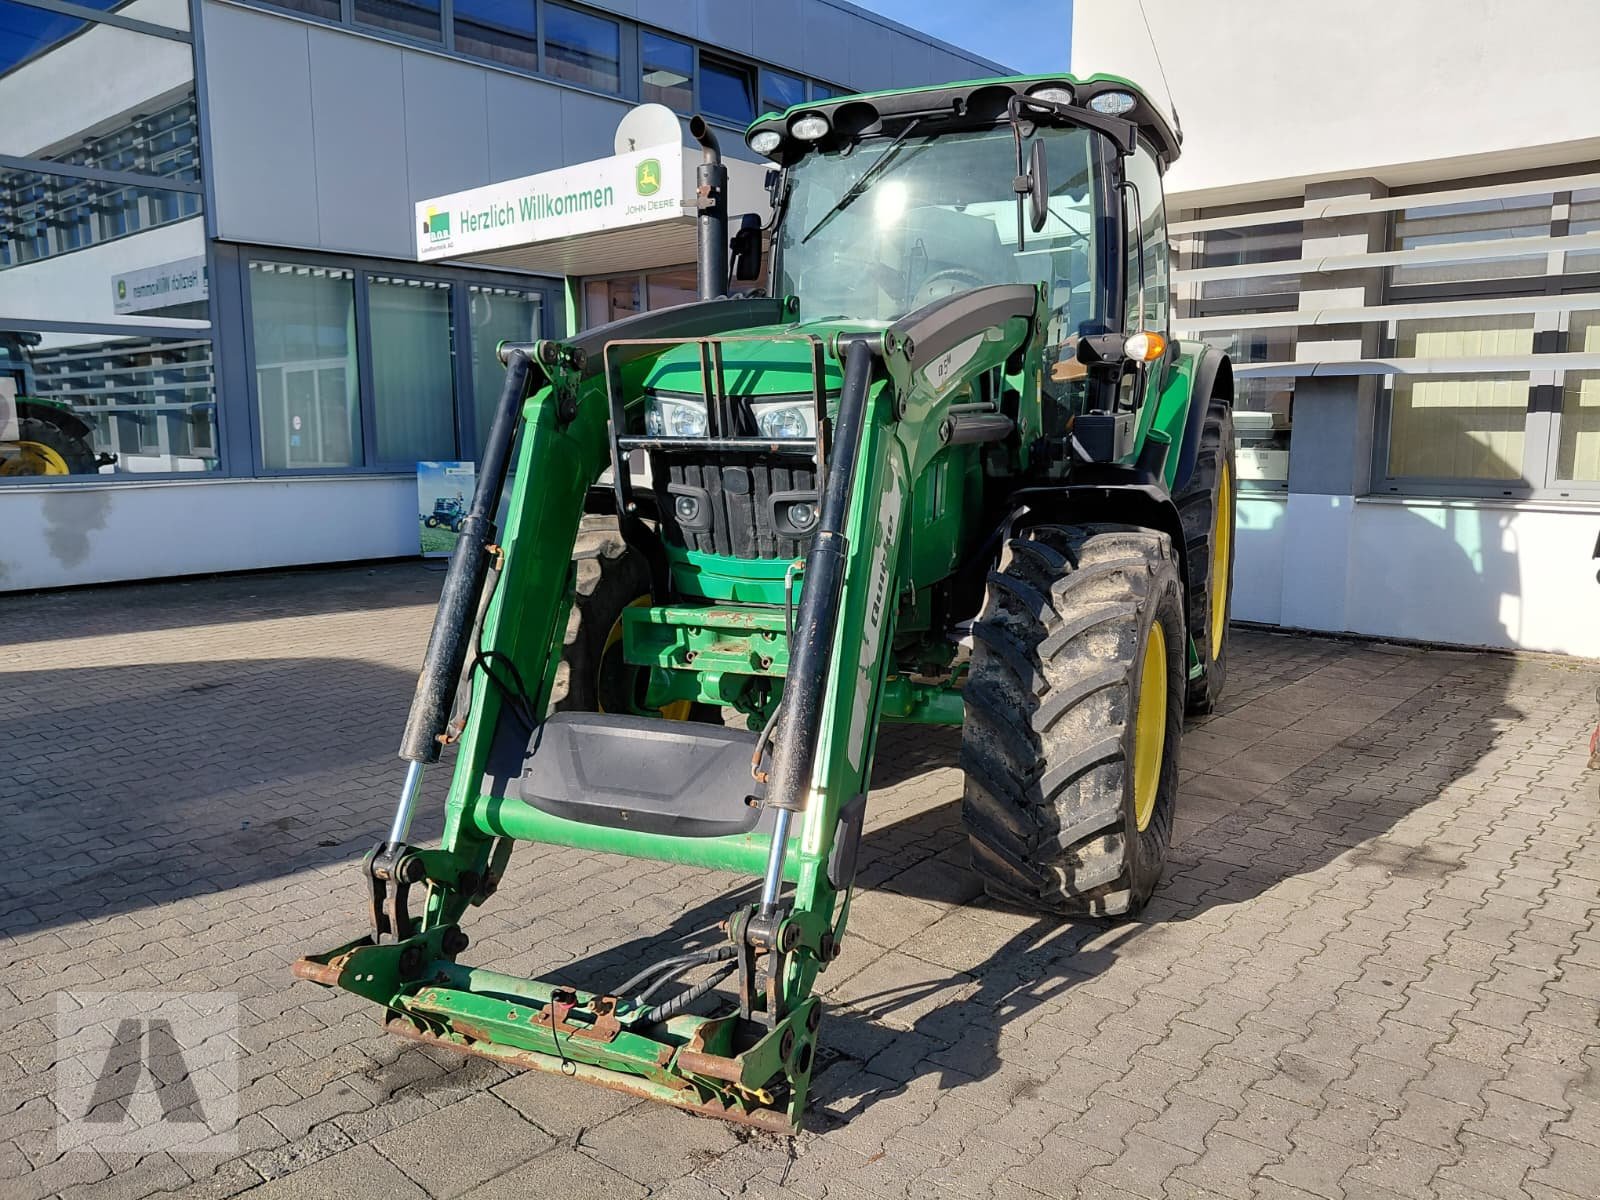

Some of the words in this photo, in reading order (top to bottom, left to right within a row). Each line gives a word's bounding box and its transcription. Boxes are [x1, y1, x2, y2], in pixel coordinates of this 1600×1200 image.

[460, 203, 515, 234] Herzlich
[518, 185, 614, 222] Willkommen
[647, 198, 675, 211] DEERE
